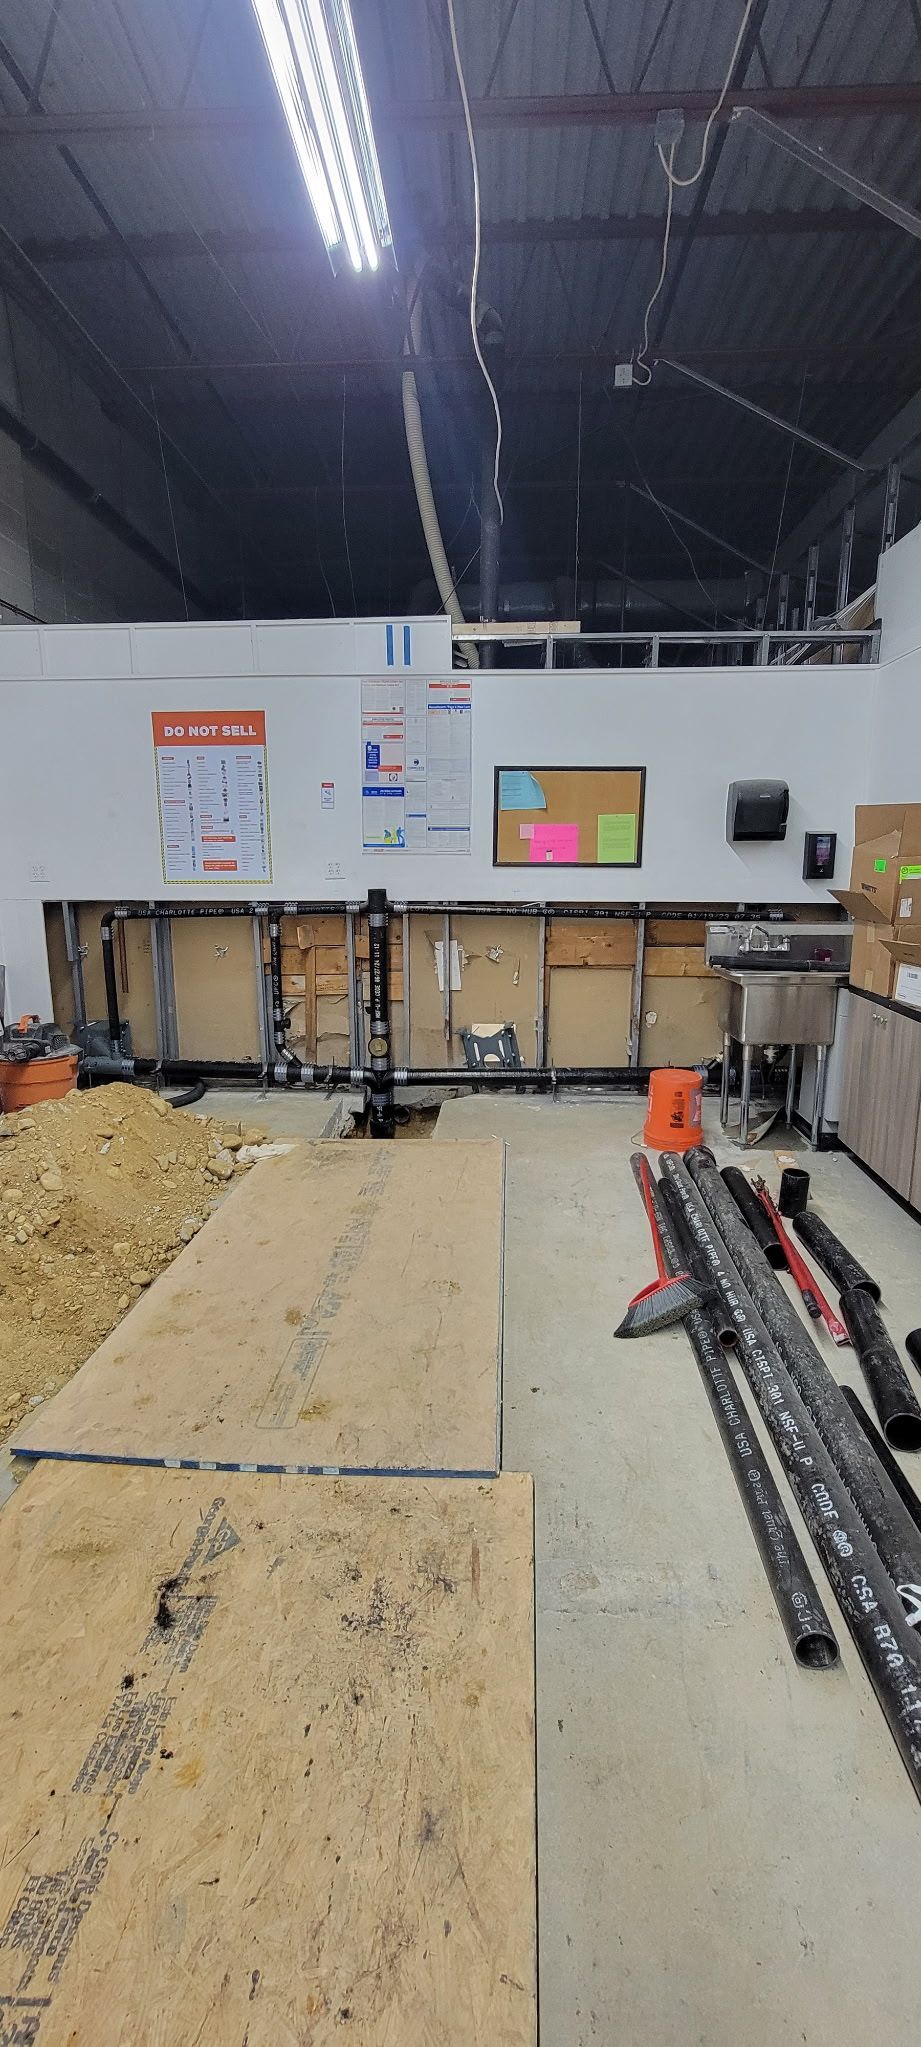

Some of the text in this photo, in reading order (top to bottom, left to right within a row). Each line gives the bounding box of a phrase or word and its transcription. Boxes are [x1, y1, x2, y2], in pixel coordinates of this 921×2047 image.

[163, 725, 257, 737] DO NOT SELL
[710, 1366, 740, 1426] CHARLOTTE
[736, 1432, 752, 1458] USA
[742, 1328, 757, 1346] USA
[851, 1576, 878, 1614] CSA
[102, 1832, 119, 1853] Ce
[47, 1900, 92, 1982] Dessous
